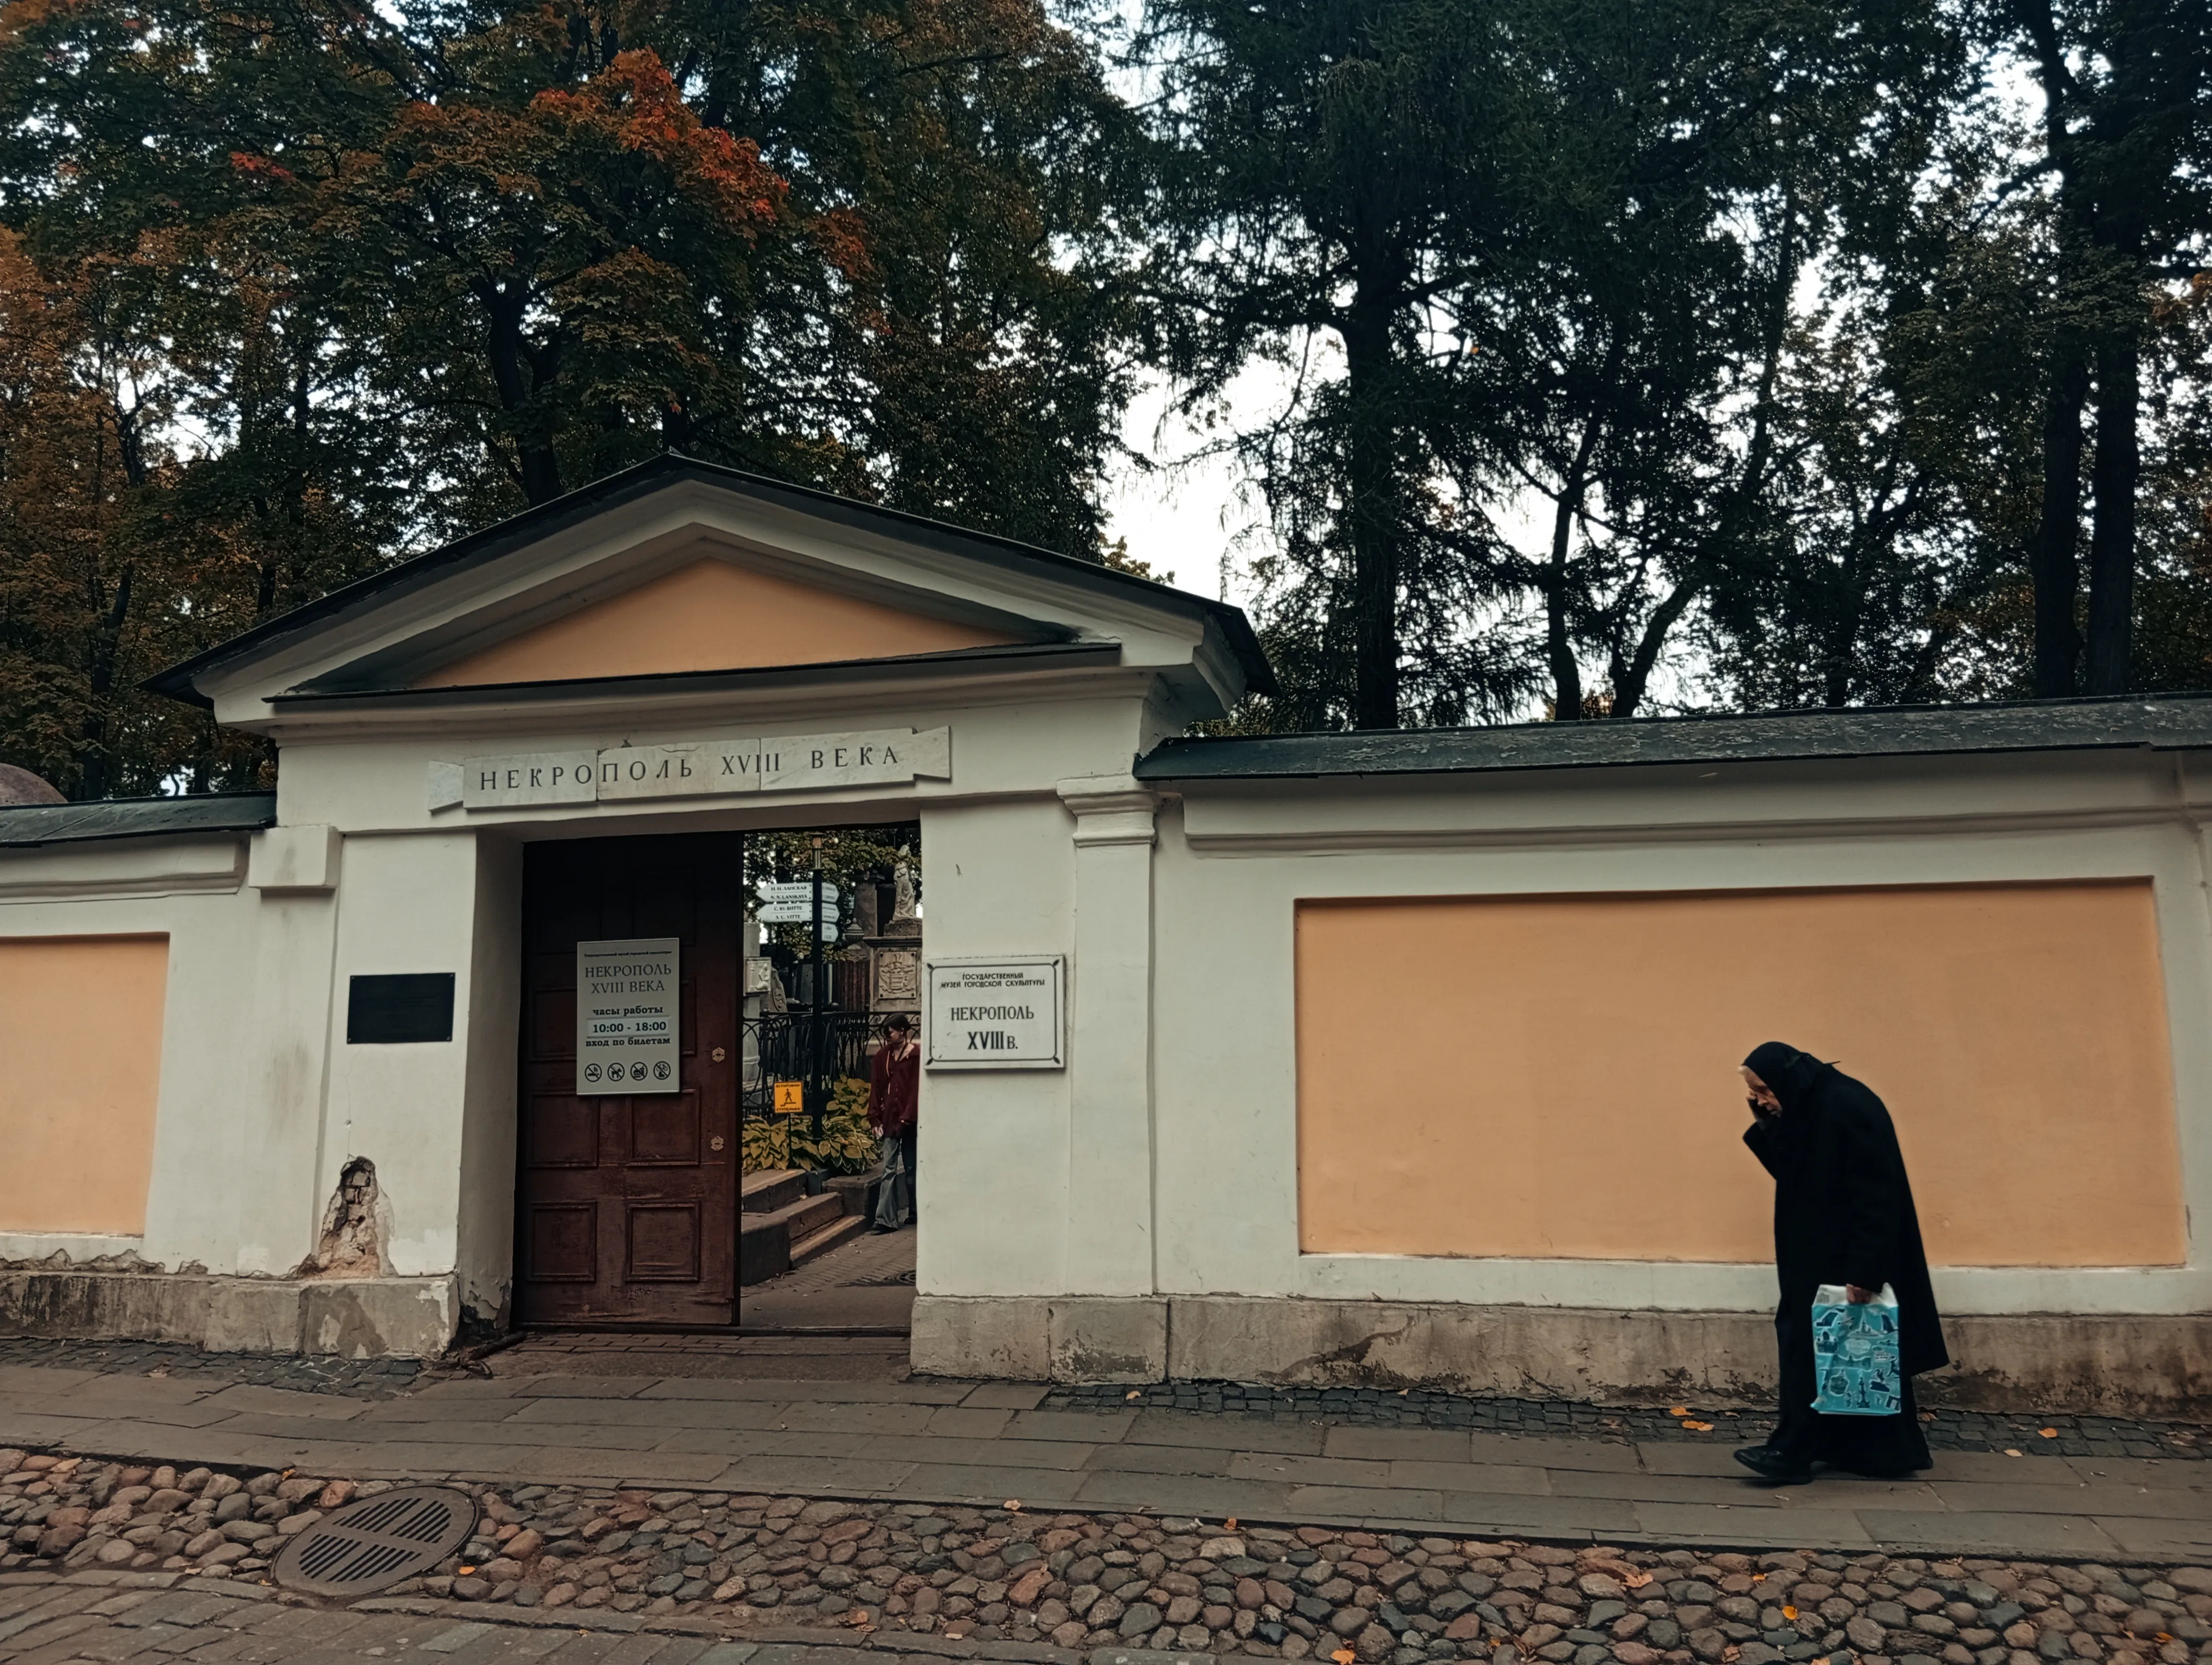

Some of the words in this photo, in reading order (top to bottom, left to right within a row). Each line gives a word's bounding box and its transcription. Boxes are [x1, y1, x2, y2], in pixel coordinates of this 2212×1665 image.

[480, 759, 692, 790] НЕКРОПОЛЬ
[721, 753, 780, 775] XVIII
[811, 745, 898, 769] ВЕКА
[585, 964, 672, 978] НЕКРОПОЛЬ
[591, 982, 623, 994] XVIII
[629, 980, 665, 993] ВЕКА
[964, 980, 1002, 988] ГОРОДСКОЙ
[593, 1007, 620, 1015] часы
[623, 1005, 663, 1017] работы
[950, 1006, 1034, 1021] НЕКРОПОЛЬ
[593, 1023, 623, 1033] 10:00
[635, 1021, 666, 1032] 18:00
[628, 1037, 670, 1045] билетам
